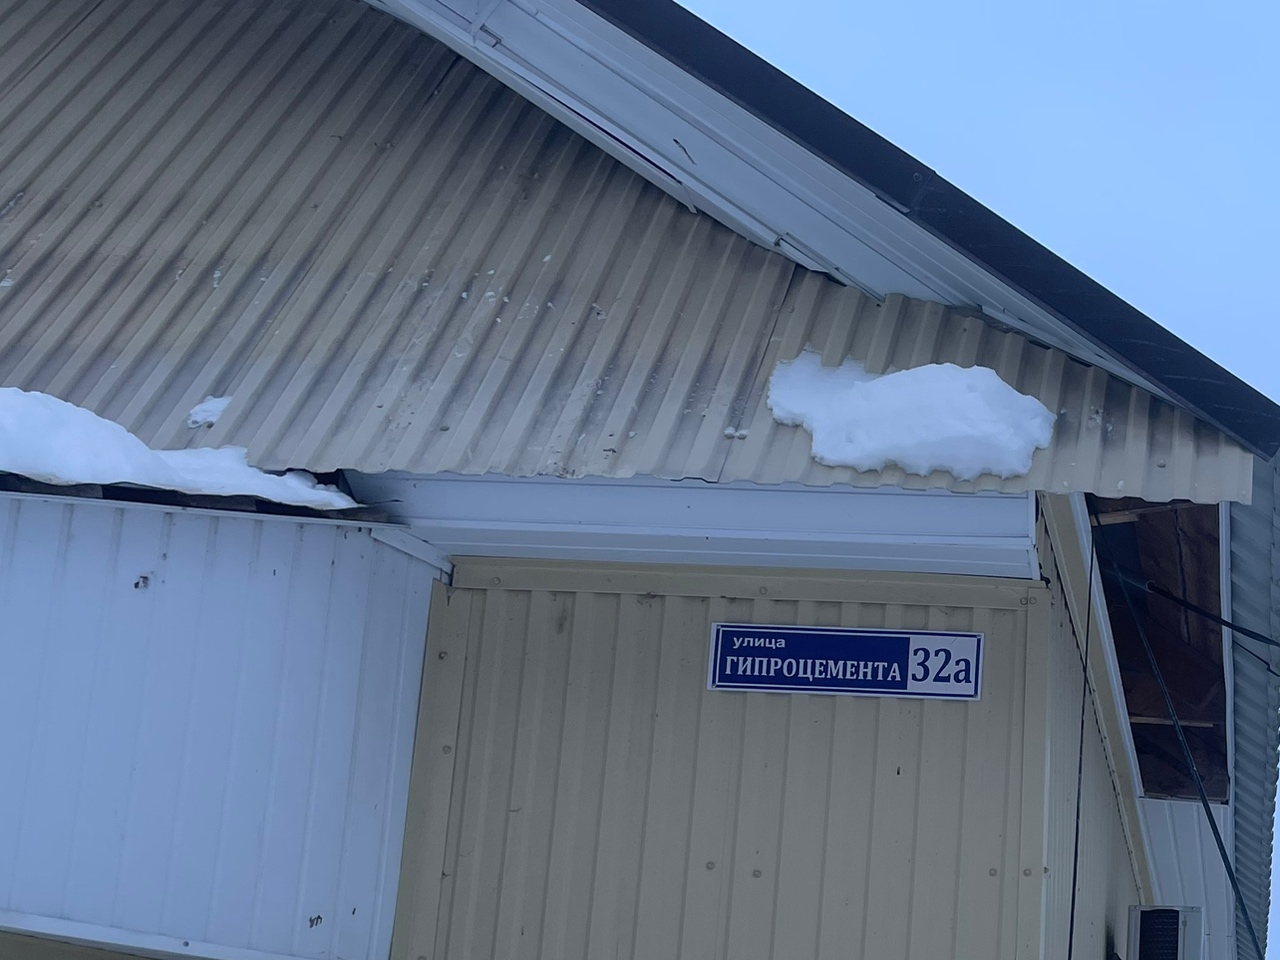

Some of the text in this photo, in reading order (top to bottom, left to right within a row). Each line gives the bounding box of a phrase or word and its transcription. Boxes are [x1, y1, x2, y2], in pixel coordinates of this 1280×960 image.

[732, 636, 786, 648] улица
[725, 647, 972, 684] ГИПРОЦЕМЕНТА 32а
